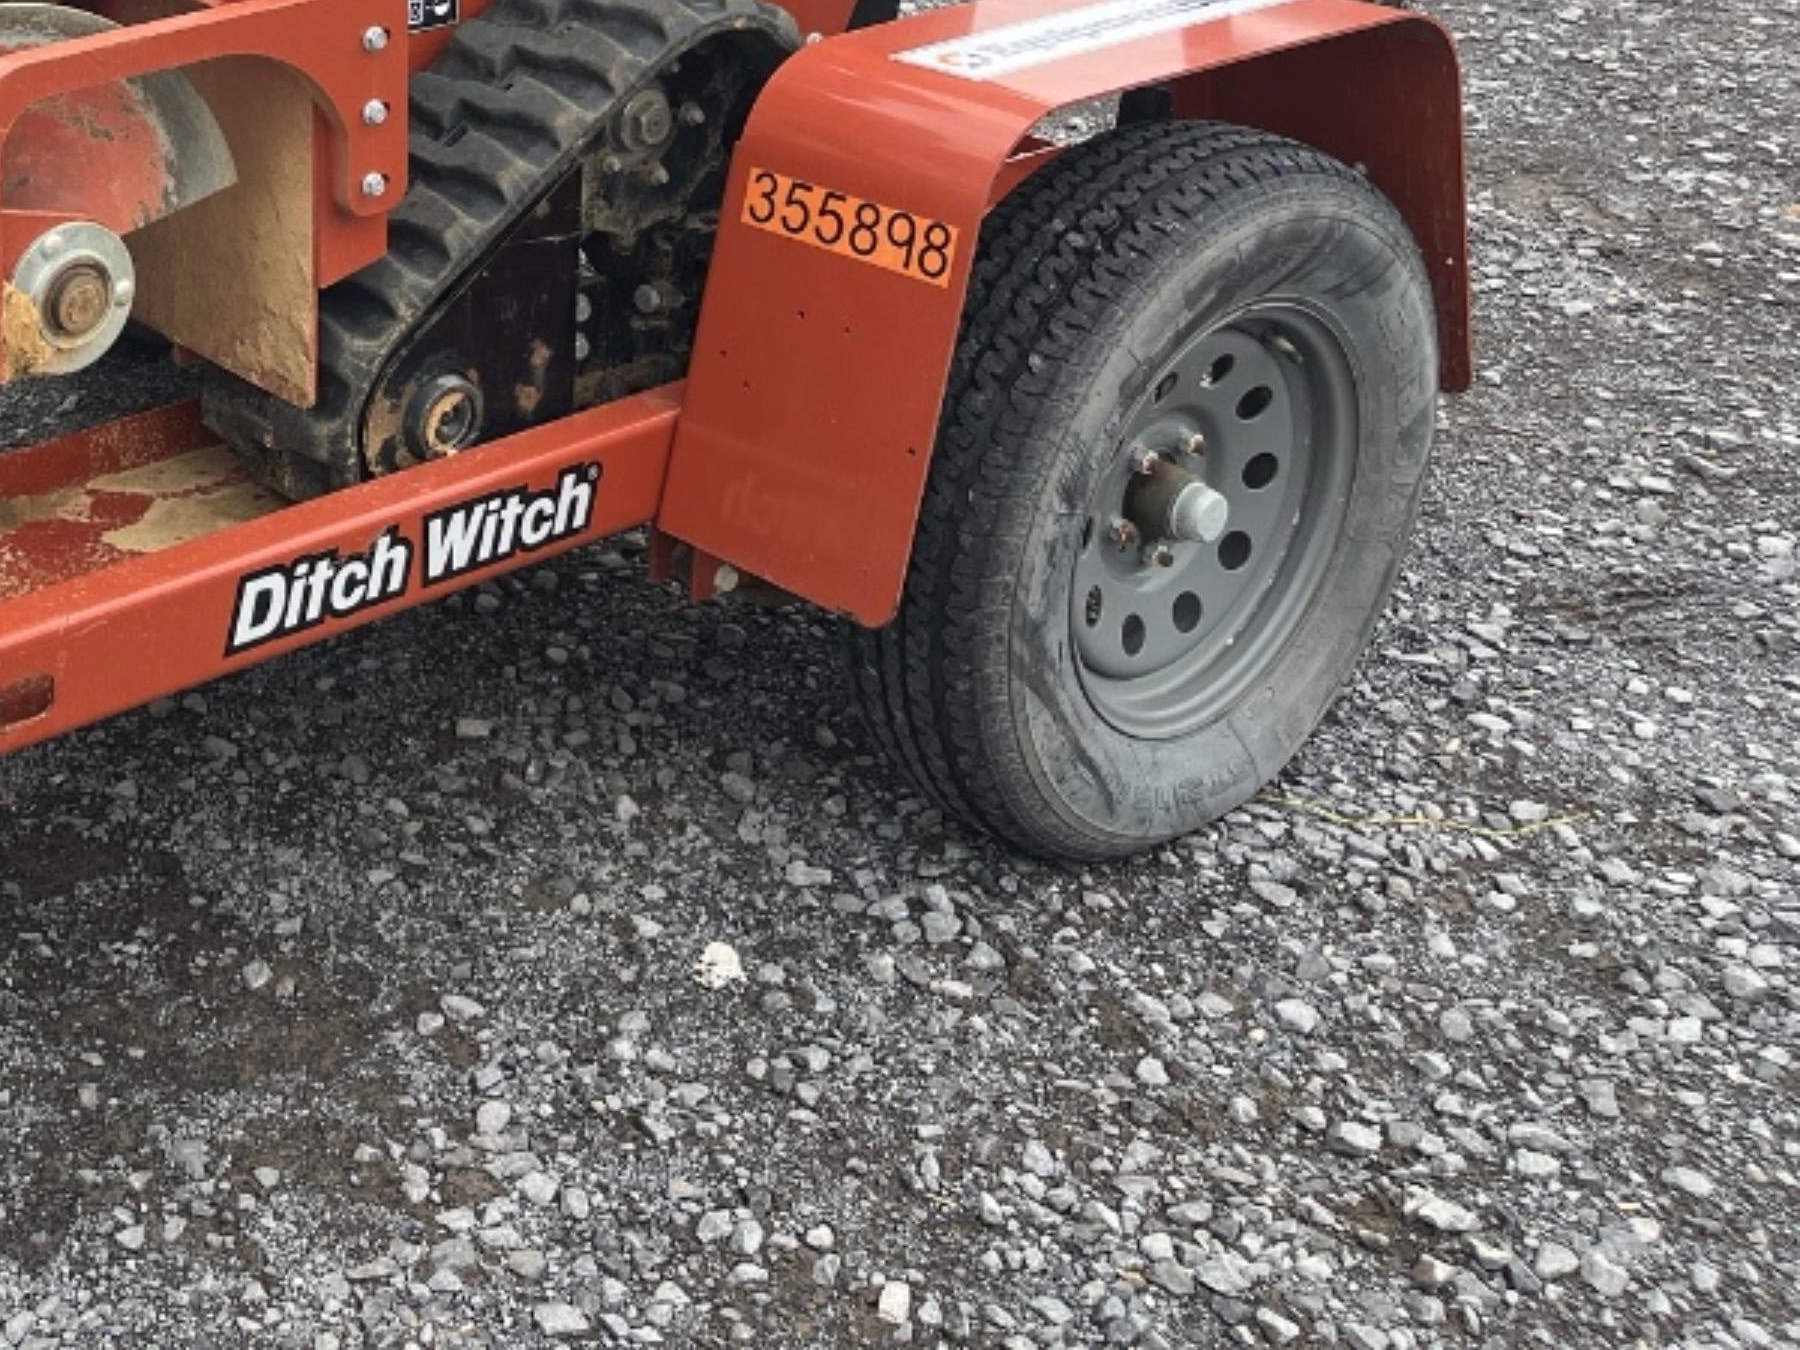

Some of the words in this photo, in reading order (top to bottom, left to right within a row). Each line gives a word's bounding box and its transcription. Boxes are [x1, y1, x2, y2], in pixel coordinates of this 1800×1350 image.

[748, 171, 952, 279] 355898
[232, 532, 410, 648] Ditch
[426, 471, 593, 580] Witch
